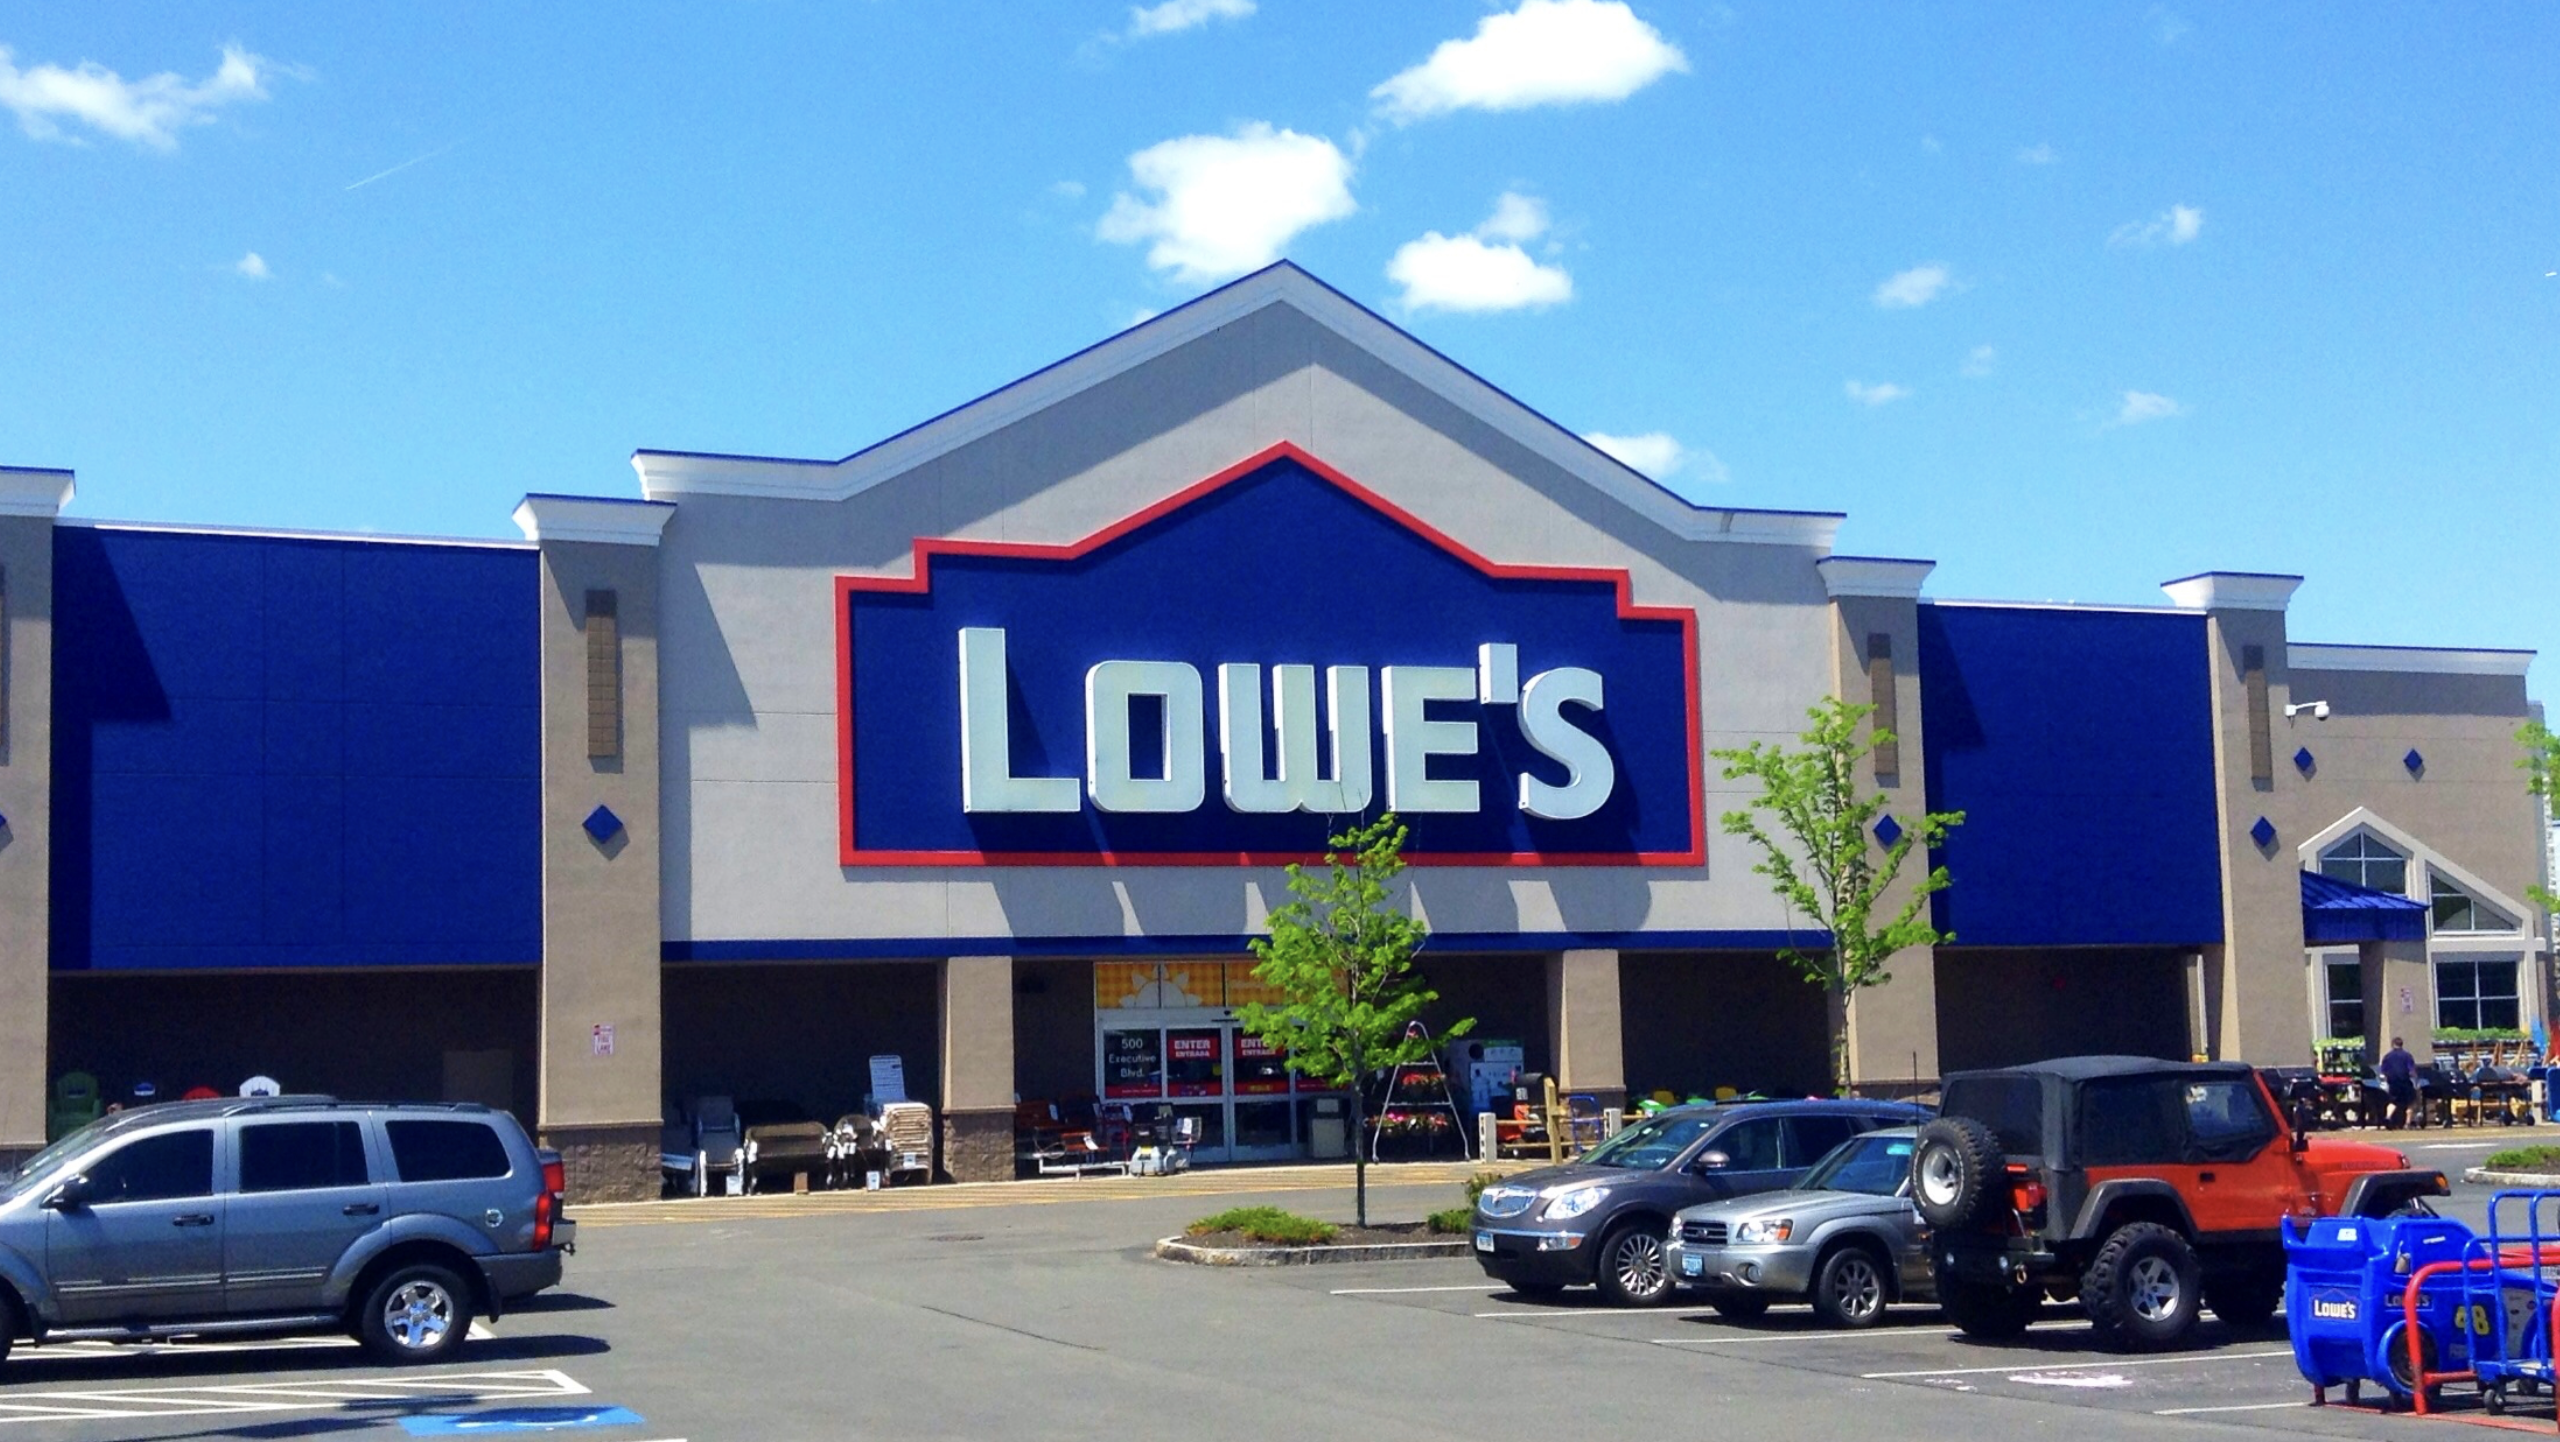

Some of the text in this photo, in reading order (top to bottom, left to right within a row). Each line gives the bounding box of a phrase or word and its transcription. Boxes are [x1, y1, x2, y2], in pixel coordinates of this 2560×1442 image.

[958, 626, 1615, 820] LOWE'S
[1121, 1038, 1143, 1049] 500
[1174, 1039, 1211, 1050] ENTER
[1108, 1053, 1157, 1064] Executive
[2314, 1299, 2356, 1319] LOWE'S
